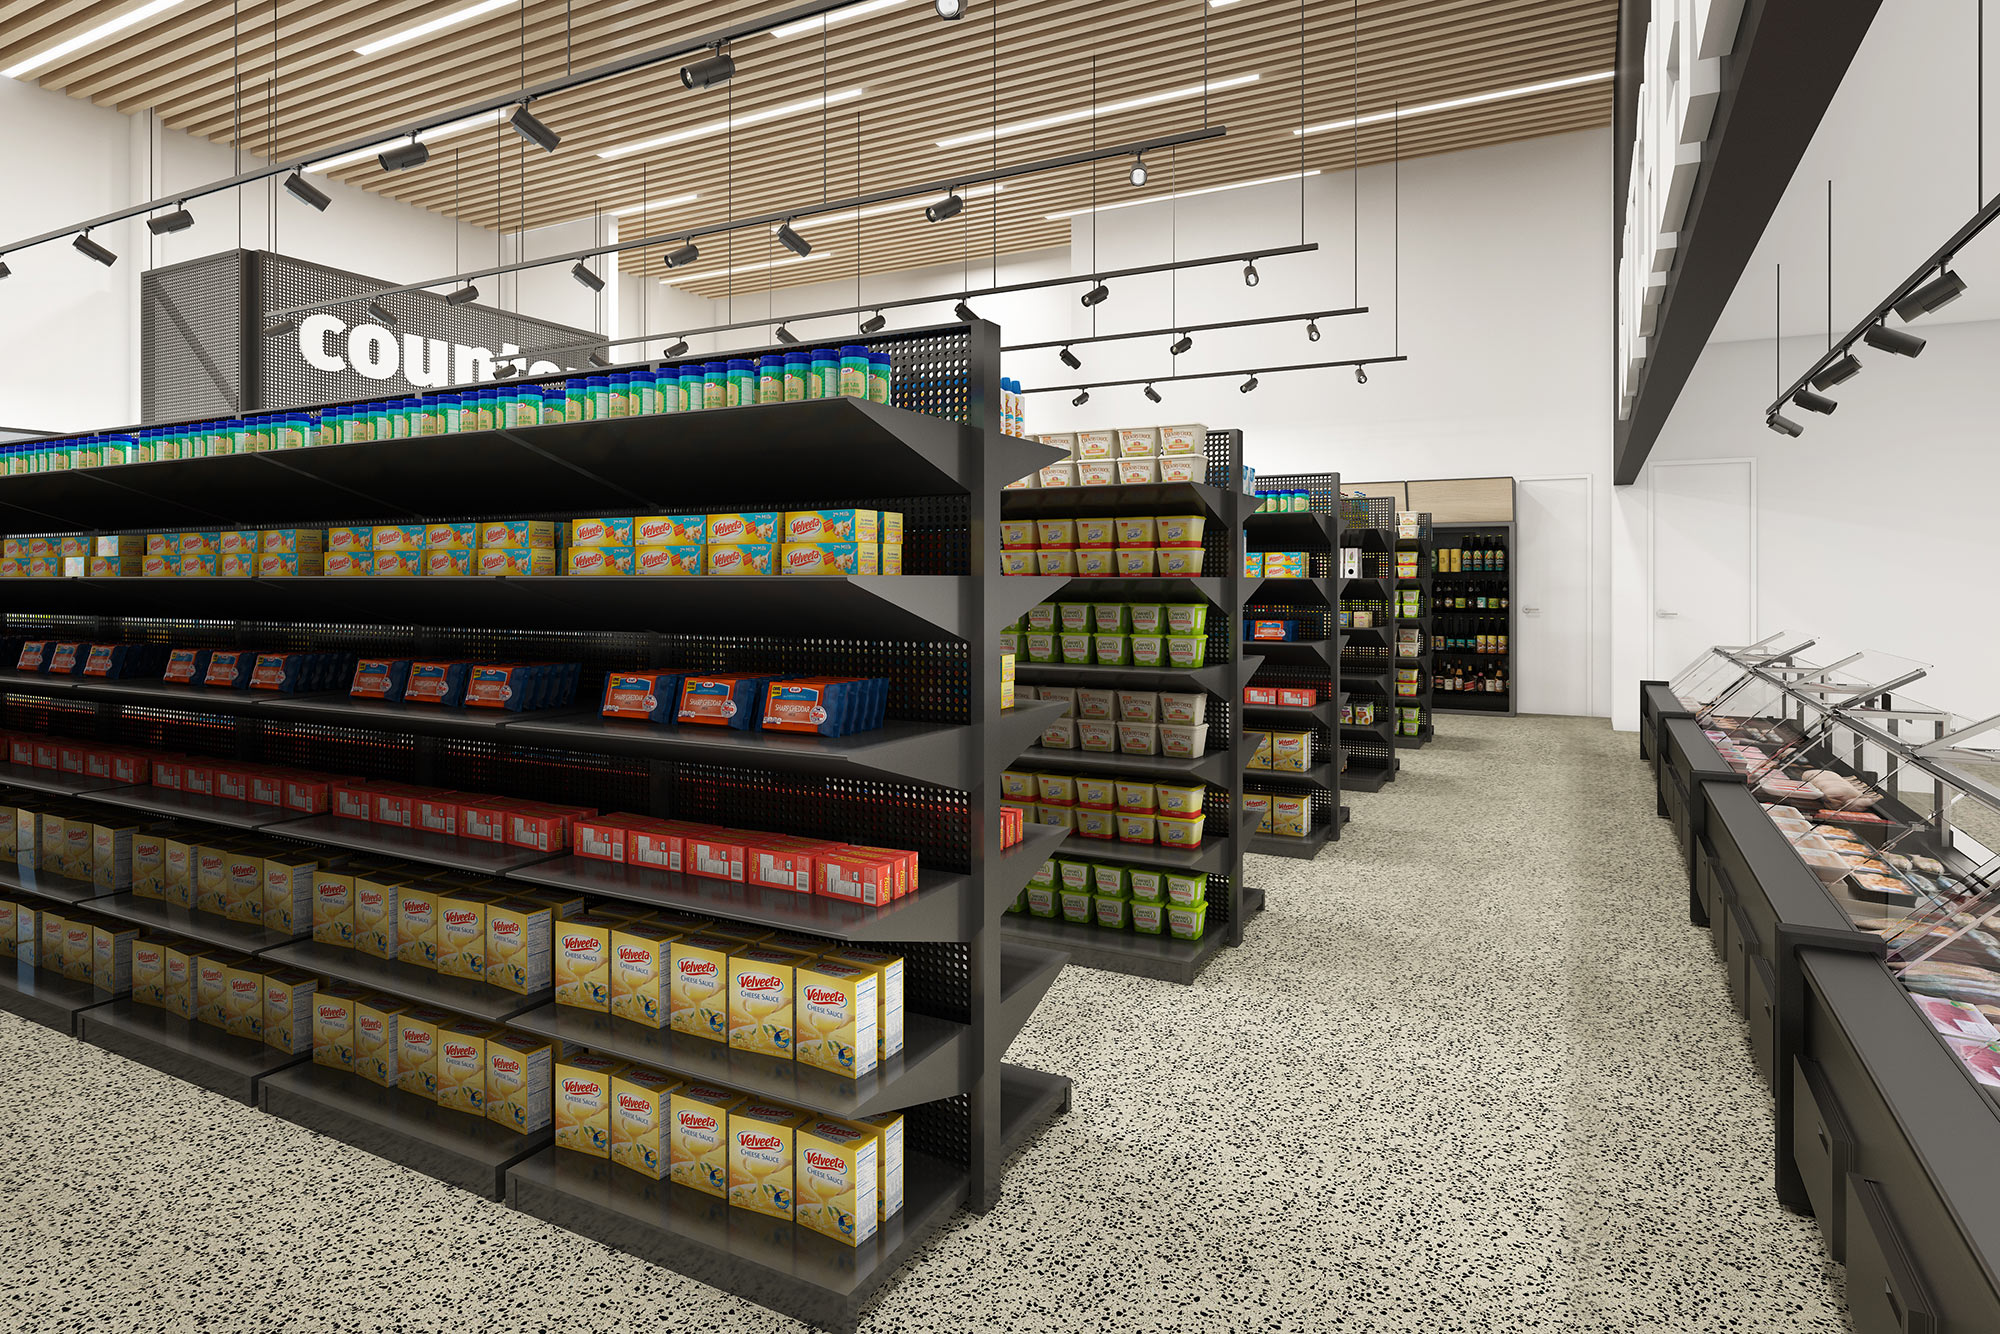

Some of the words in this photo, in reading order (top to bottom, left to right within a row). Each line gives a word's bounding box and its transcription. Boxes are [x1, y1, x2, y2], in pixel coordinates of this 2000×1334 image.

[578, 525, 602, 538] Velveeta
[642, 522, 670, 538] Velveeta
[714, 520, 742, 536] Velveeta
[791, 518, 820, 534] Velveeta
[575, 553, 602, 568] Velveeta
[642, 552, 667, 567] Velveeta
[714, 552, 739, 566] Velveeta
[789, 551, 819, 566] Velveeta
[319, 884, 346, 894] Velveeta
[361, 892, 381, 903] Velveeta
[403, 901, 430, 913] Velveeta
[446, 911, 475, 924] Velveeta
[493, 920, 518, 933] Velveeta
[564, 936, 598, 949] Velveeta
[619, 948, 650, 961] Velveeta
[680, 961, 715, 973] Velveeta
[740, 975, 780, 988] Velveeta
[806, 989, 844, 1002] Velveeta
[319, 1007, 346, 1018] Velveeta
[361, 1017, 381, 1029] Velveeta
[403, 1030, 430, 1042] Velveeta
[446, 1045, 475, 1057] Velveeta
[493, 1057, 519, 1071] Velveeta
[564, 1080, 598, 1093] Velveeta
[619, 1095, 650, 1110] Velveeta
[680, 1113, 715, 1127] Velveeta
[740, 1134, 780, 1147] Velveeta
[806, 1152, 844, 1168] Velveeta
